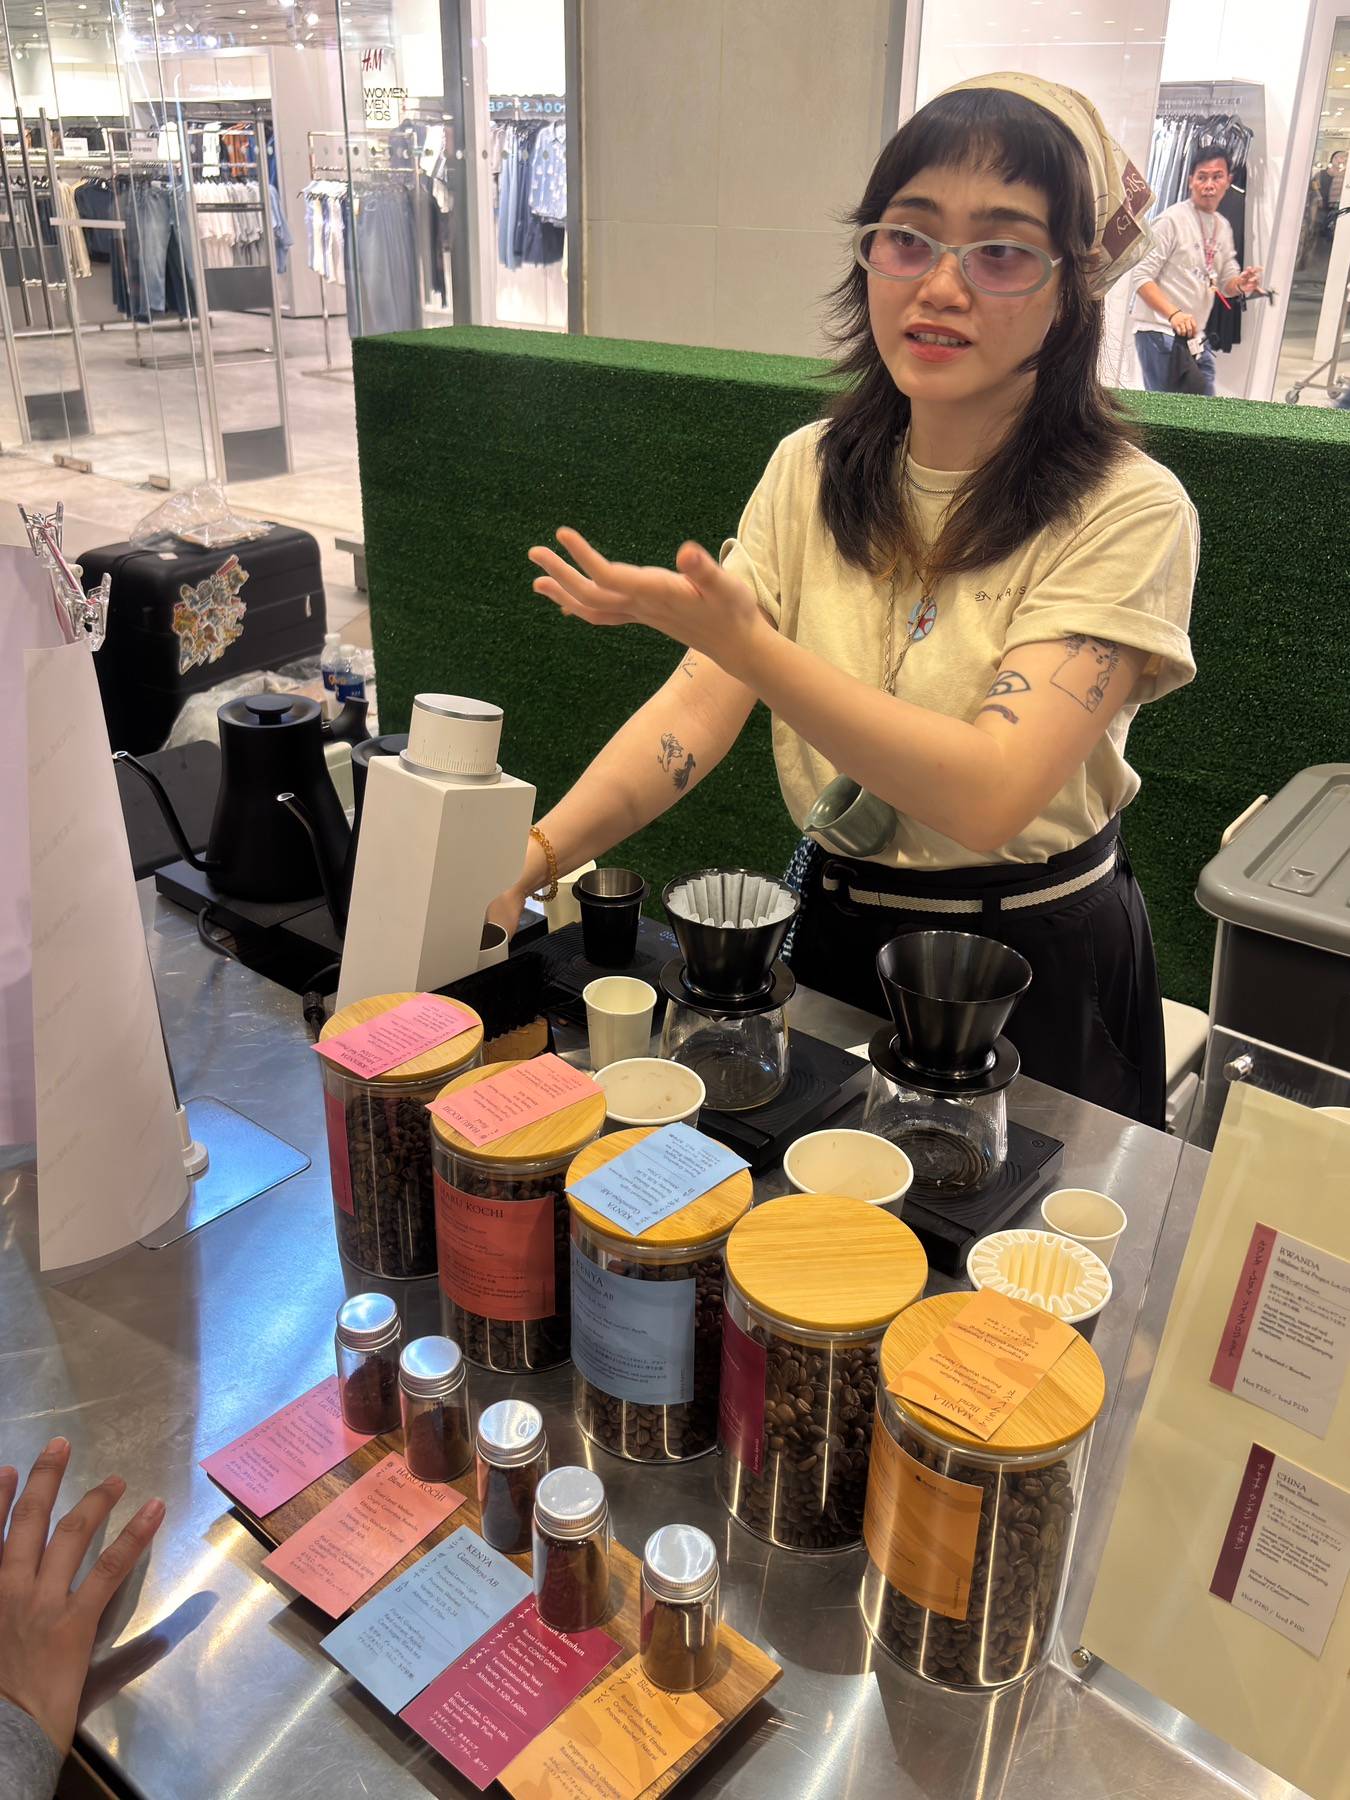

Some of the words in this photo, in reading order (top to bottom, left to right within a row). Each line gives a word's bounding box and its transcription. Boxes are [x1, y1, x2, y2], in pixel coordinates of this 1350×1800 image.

[361, 48, 383, 72] H&M
[363, 87, 409, 98] WOMEN
[364, 99, 390, 110] MEN
[364, 110, 392, 121] KIDS
[466, 1202, 504, 1219] KOCHI
[604, 1201, 633, 1219] KENYA
[1278, 1246, 1320, 1271] RWANDA
[929, 1392, 975, 1419] MANILA
[956, 1397, 981, 1413] Blend
[386, 1474, 406, 1488] Blend
[394, 1466, 421, 1485] HARU
[416, 1481, 447, 1502] KOCHI
[1276, 1470, 1307, 1493] CHINA
[464, 1543, 495, 1568] KENYA
[486, 1576, 500, 1587] AB
[505, 1642, 525, 1657] Coffee
[520, 1628, 538, 1642] Roast
[545, 1648, 571, 1667] Medium
[555, 1632, 590, 1657] Baoshan
[525, 1645, 546, 1661] CONG
[541, 1658, 561, 1673] GANG
[488, 1656, 524, 1684] Fermentation
[518, 1680, 541, 1698] Natural
[515, 1664, 533, 1678] Wine
[635, 1678, 659, 1699] Blend
[440, 1702, 453, 1714] Red
[446, 1696, 464, 1712] Blood
[452, 1690, 470, 1706] Dried
[479, 1714, 499, 1732] Cacao
